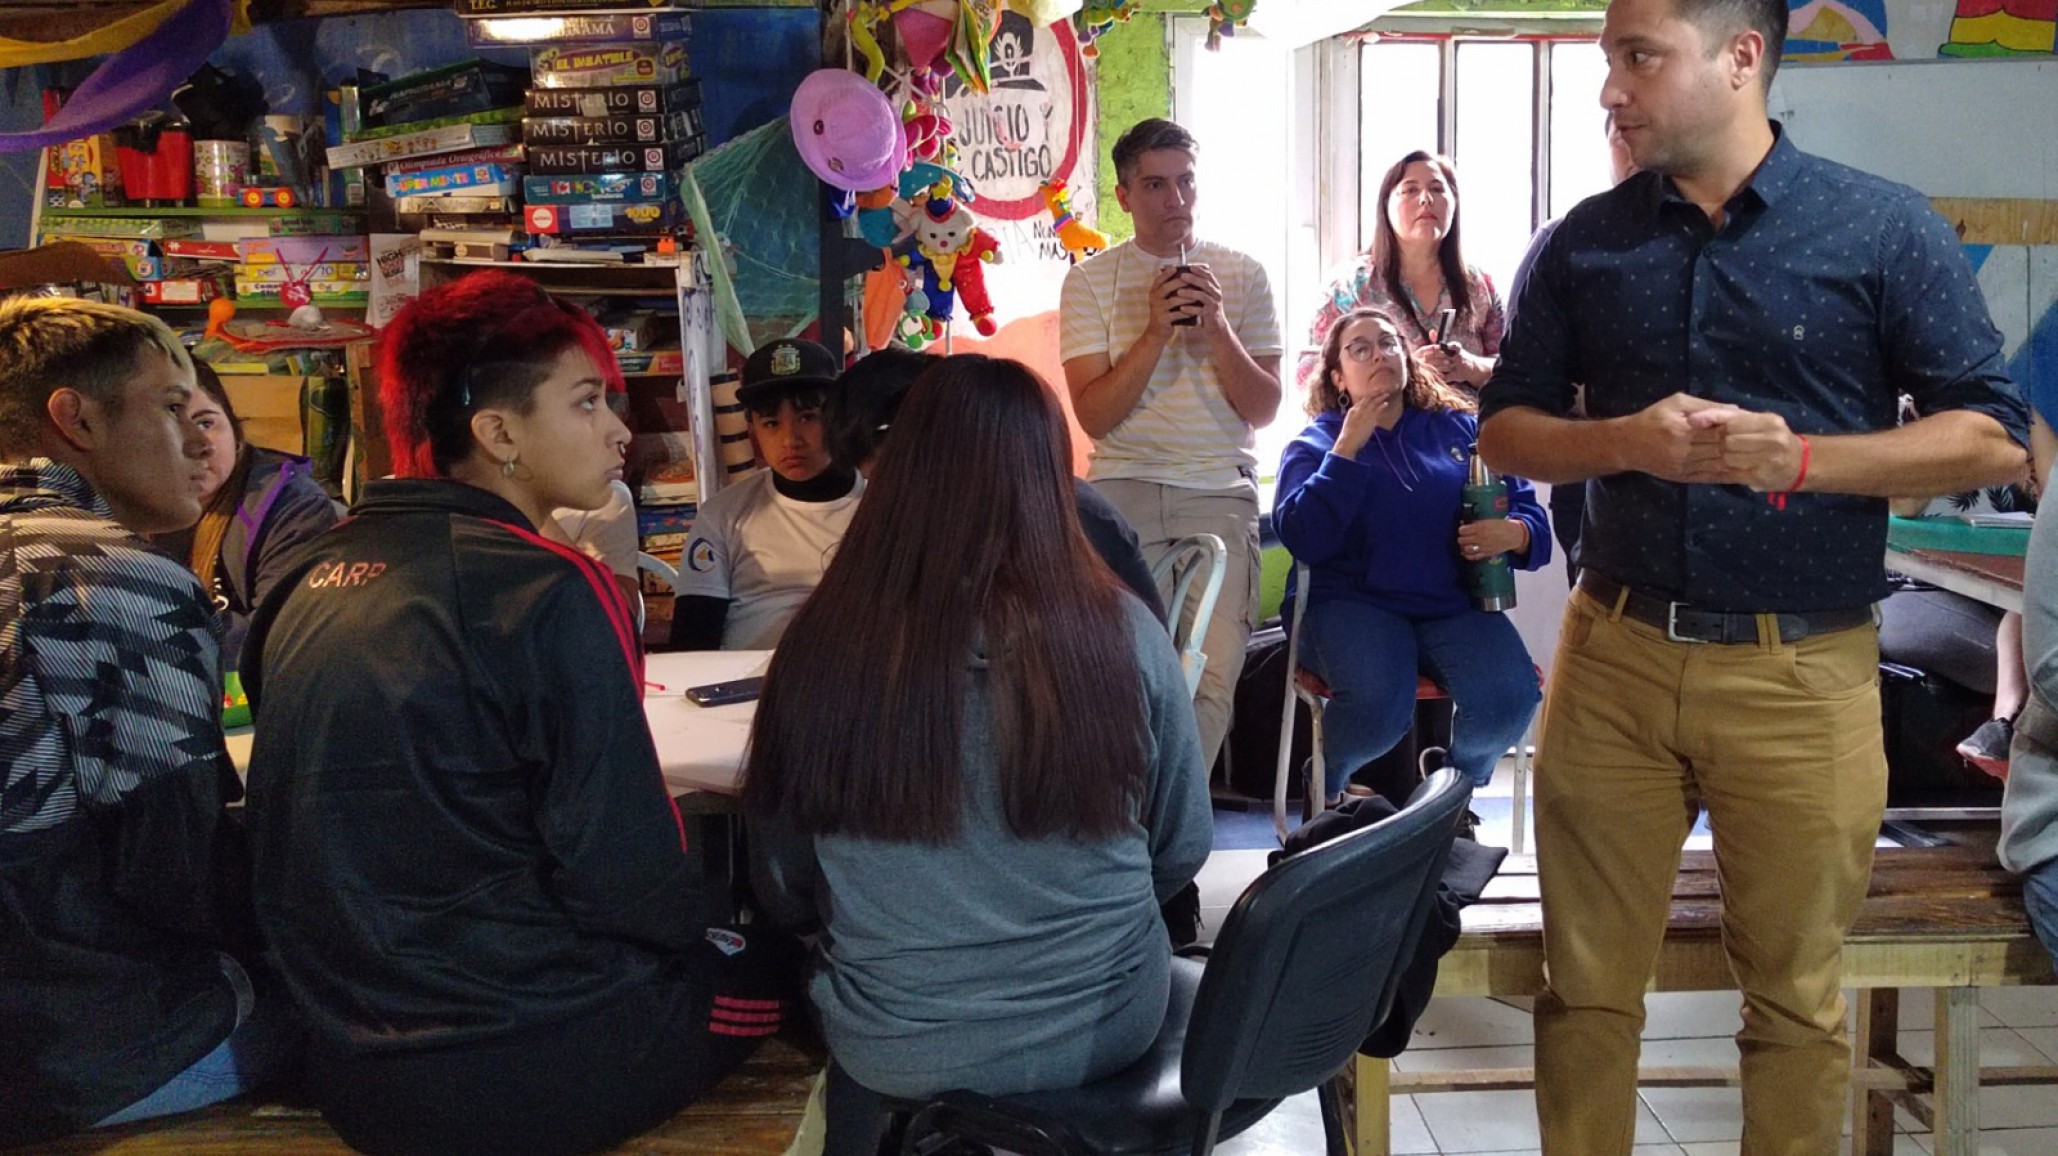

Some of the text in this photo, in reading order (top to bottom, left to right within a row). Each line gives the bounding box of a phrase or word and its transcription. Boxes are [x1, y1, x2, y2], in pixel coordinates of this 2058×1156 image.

[556, 57, 571, 71] EL
[532, 119, 628, 143] MISTERIO
[959, 103, 1053, 147] JUICIO Y
[539, 149, 636, 172] MISTERIO
[972, 144, 1052, 181] CASTIGO
[309, 560, 387, 588] CARP
